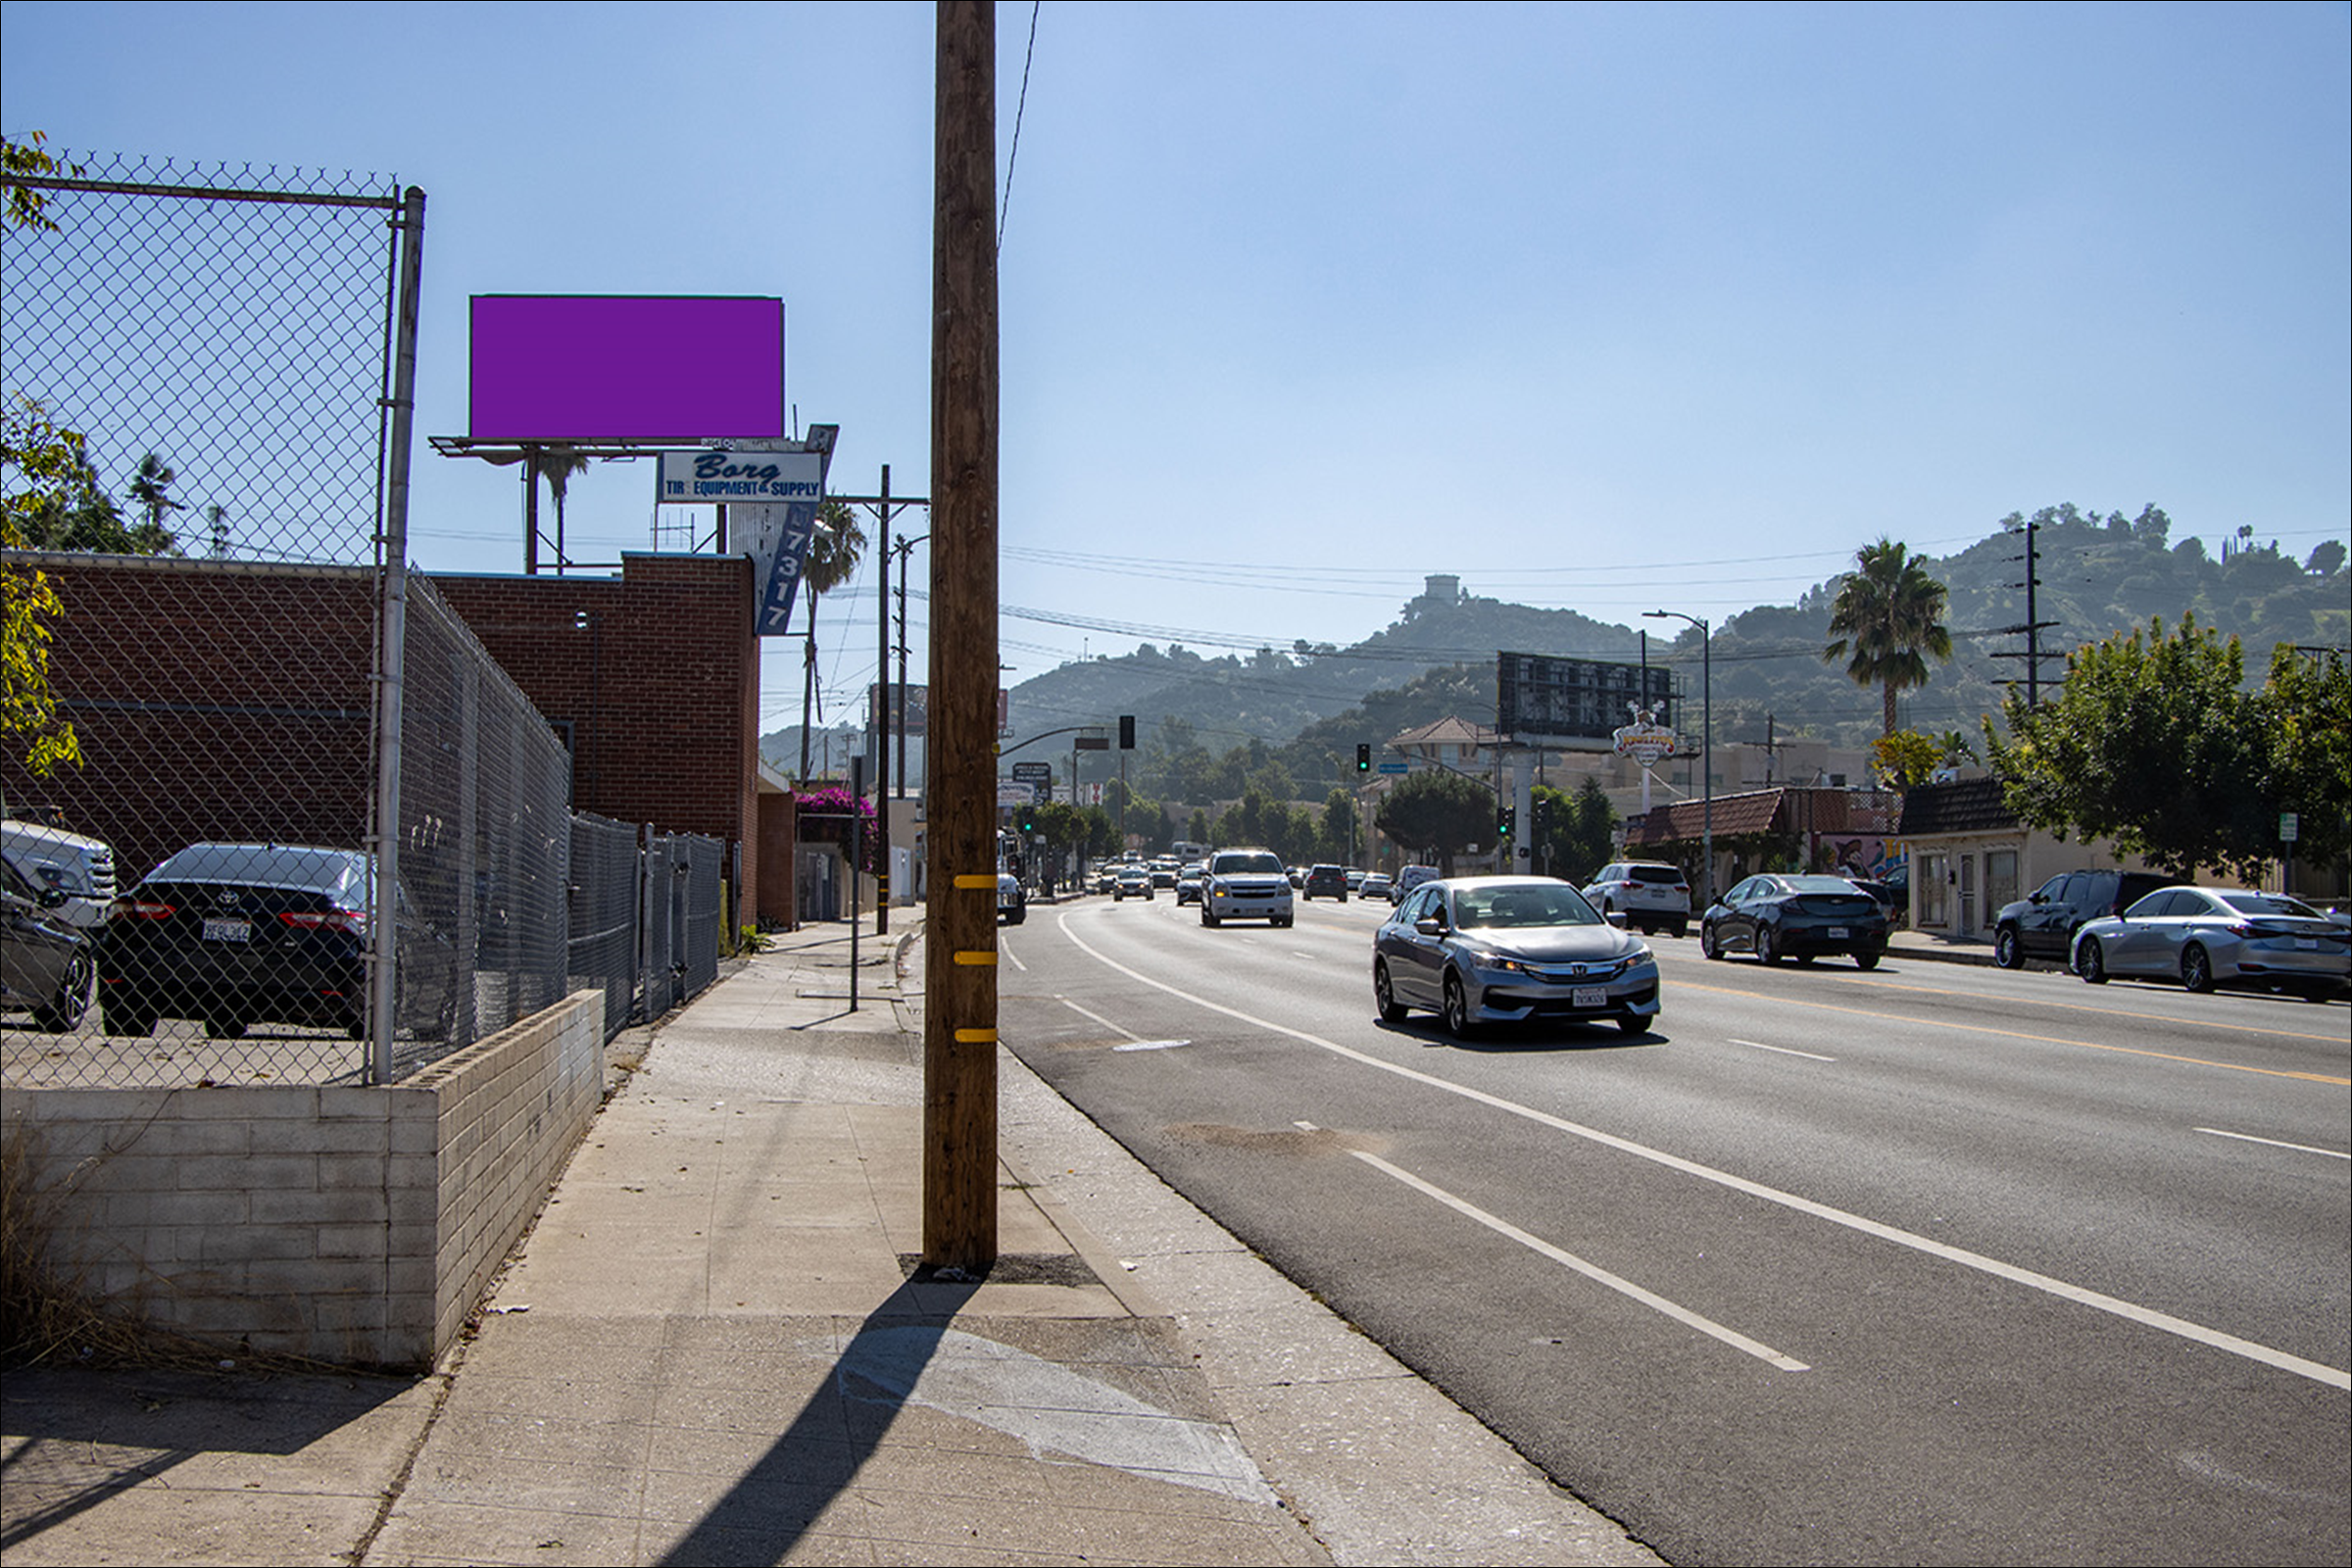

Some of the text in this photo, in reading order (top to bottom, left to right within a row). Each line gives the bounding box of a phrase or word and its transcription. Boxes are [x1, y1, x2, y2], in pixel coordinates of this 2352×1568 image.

[694, 454, 781, 483] Borg
[666, 480, 690, 495] TIR
[694, 480, 758, 497] EQUIPMENT
[771, 481, 819, 496] SUPPLY
[767, 531, 806, 627] 7317
